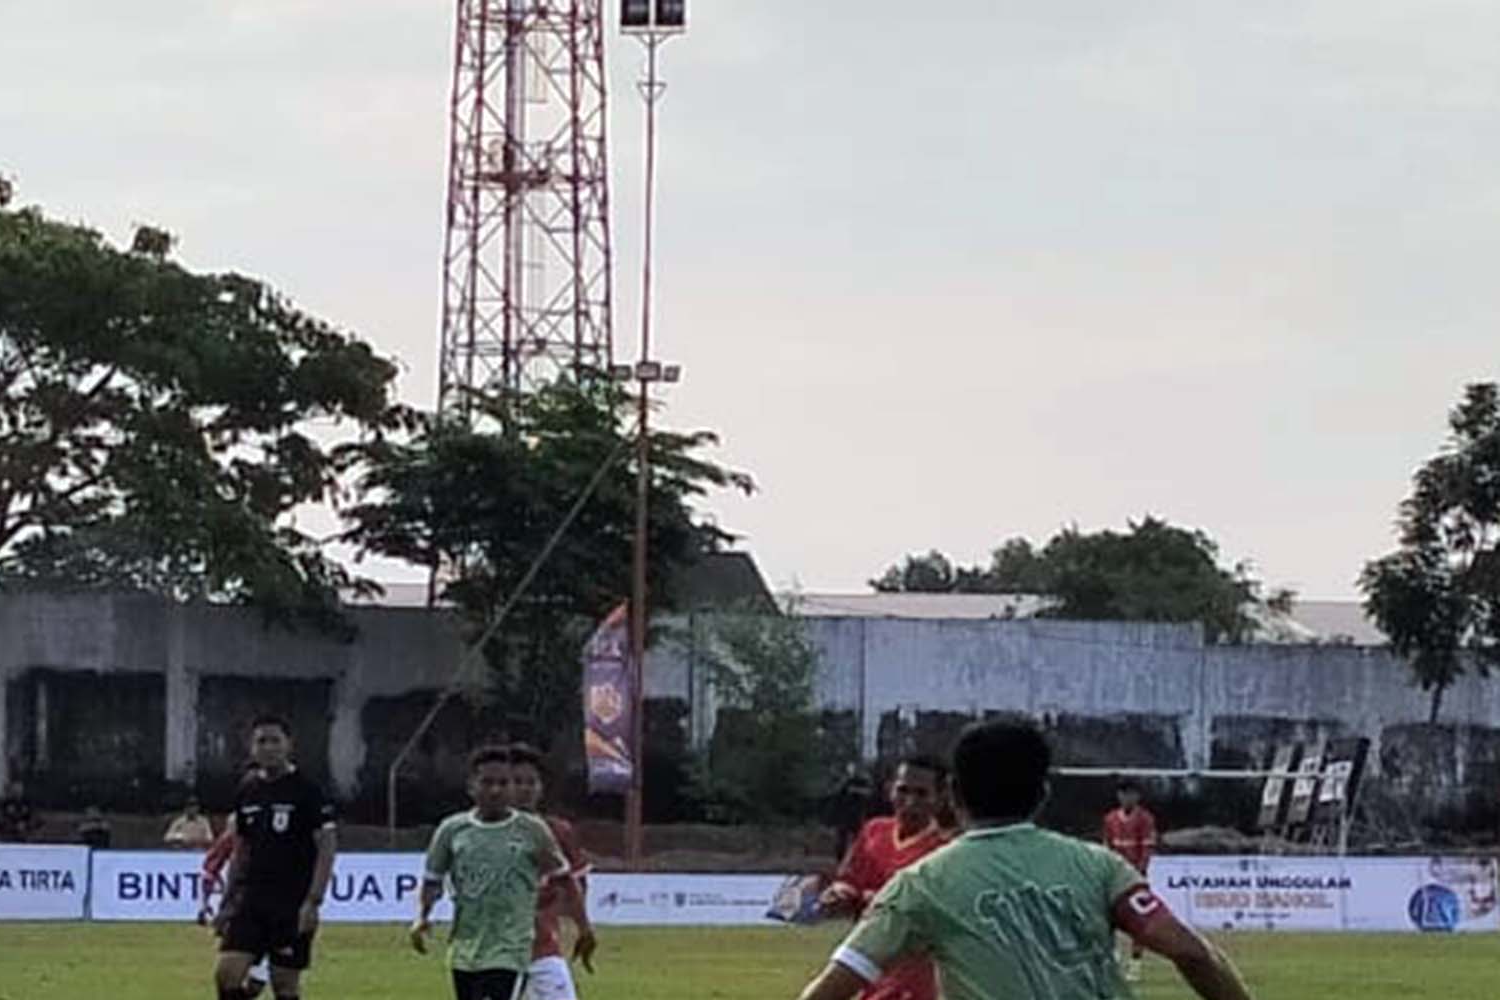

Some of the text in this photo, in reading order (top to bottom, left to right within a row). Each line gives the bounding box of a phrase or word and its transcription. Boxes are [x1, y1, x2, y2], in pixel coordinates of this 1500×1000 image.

[19, 870, 75, 891] TIRTA
[1256, 876, 1352, 889] UNGGULAN
[1130, 891, 1158, 914] C
